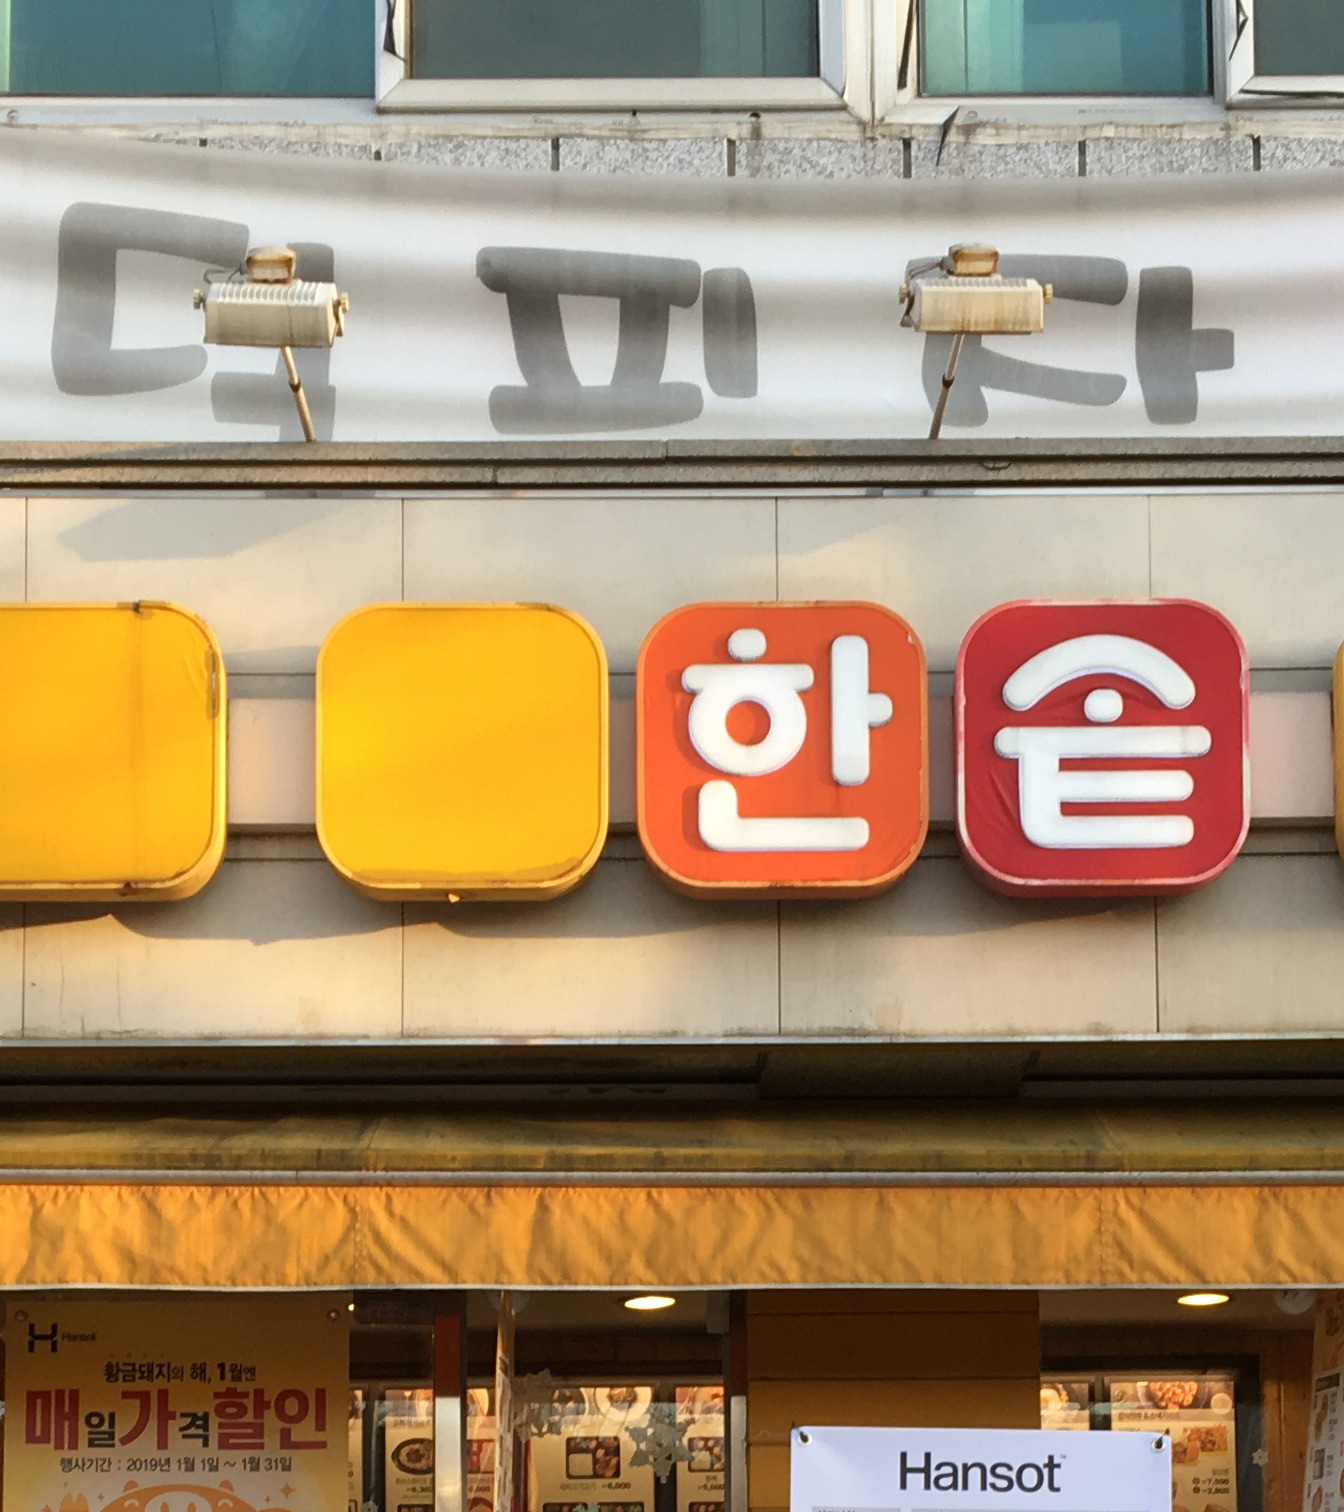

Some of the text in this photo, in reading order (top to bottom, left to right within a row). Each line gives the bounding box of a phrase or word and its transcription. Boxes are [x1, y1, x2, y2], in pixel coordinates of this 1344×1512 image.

[60, 1458, 292, 1473] 행사기간 2019년 1월 1일 1월 31일
[899, 1451, 1061, 1492] Hansot
